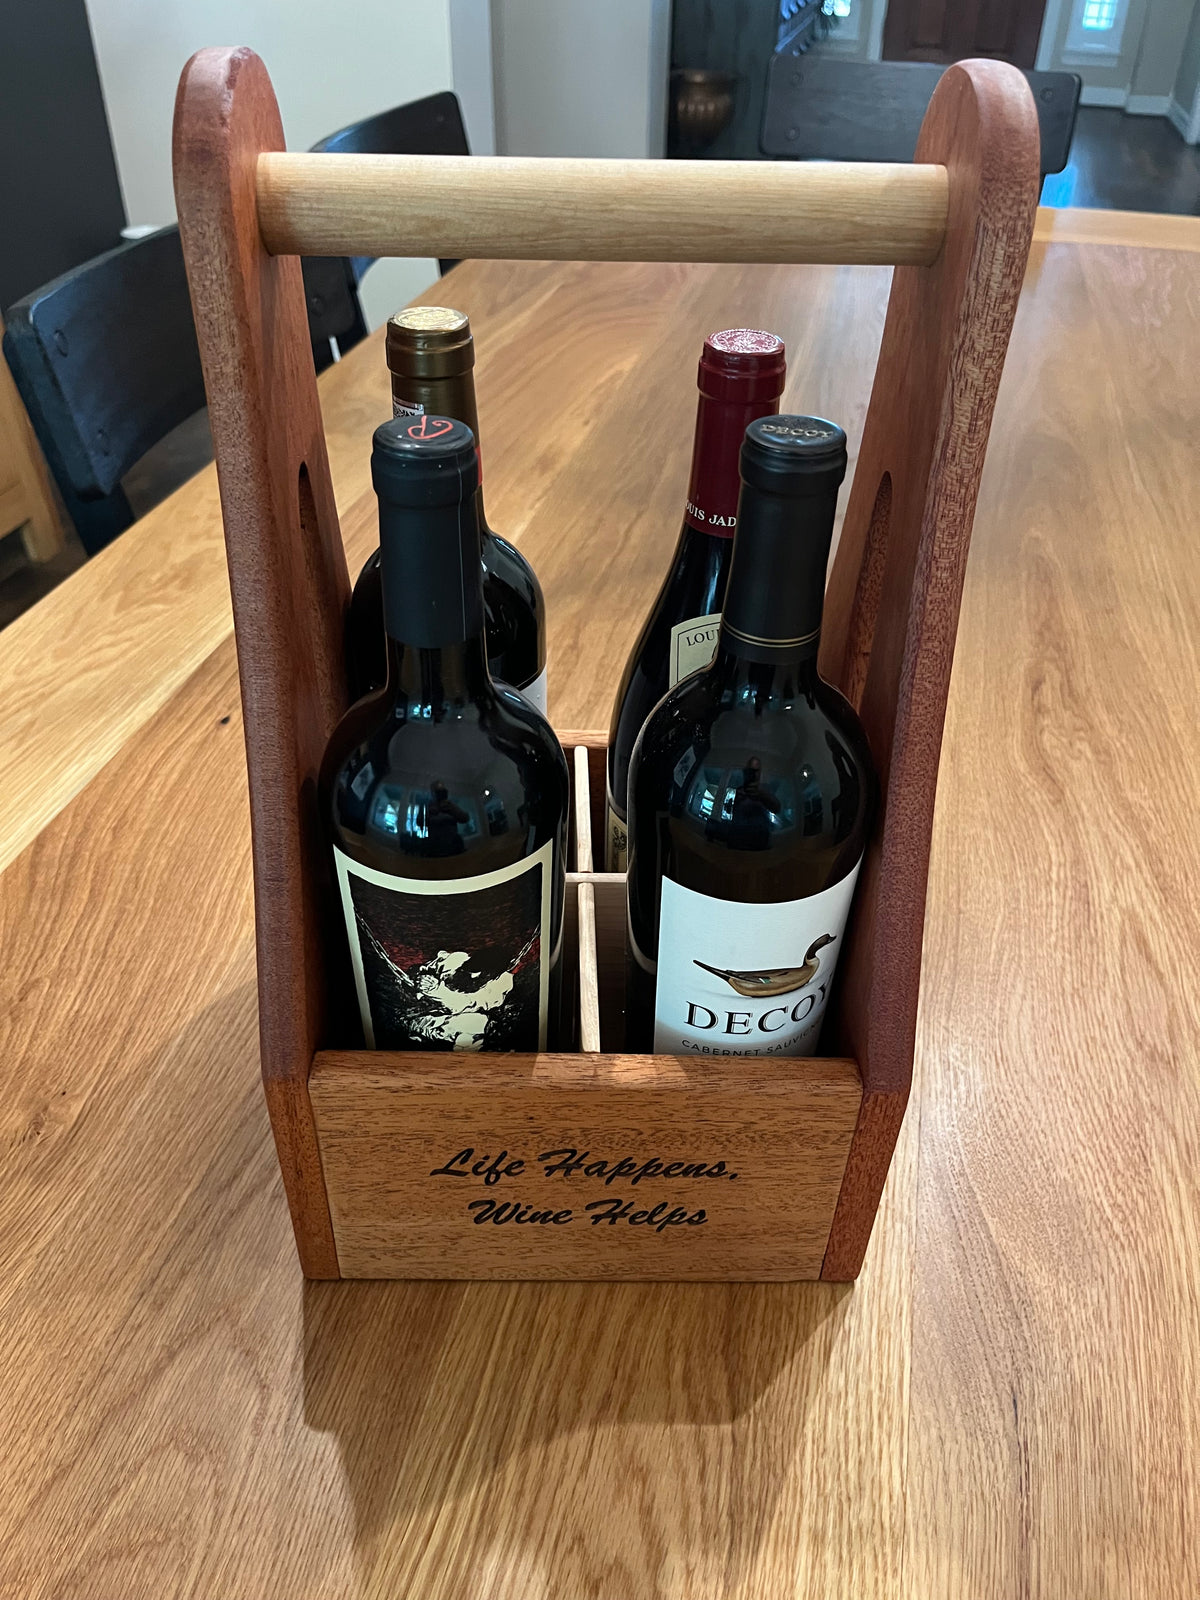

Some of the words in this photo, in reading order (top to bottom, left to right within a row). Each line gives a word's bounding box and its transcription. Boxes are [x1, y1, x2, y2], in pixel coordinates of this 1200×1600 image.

[761, 424, 833, 438] DECOY
[681, 1039, 761, 1057] CABERNET
[430, 1148, 525, 1186] Life
[537, 1148, 739, 1186] Happens.
[468, 1199, 573, 1226] Wine
[584, 1199, 708, 1233] Helps
